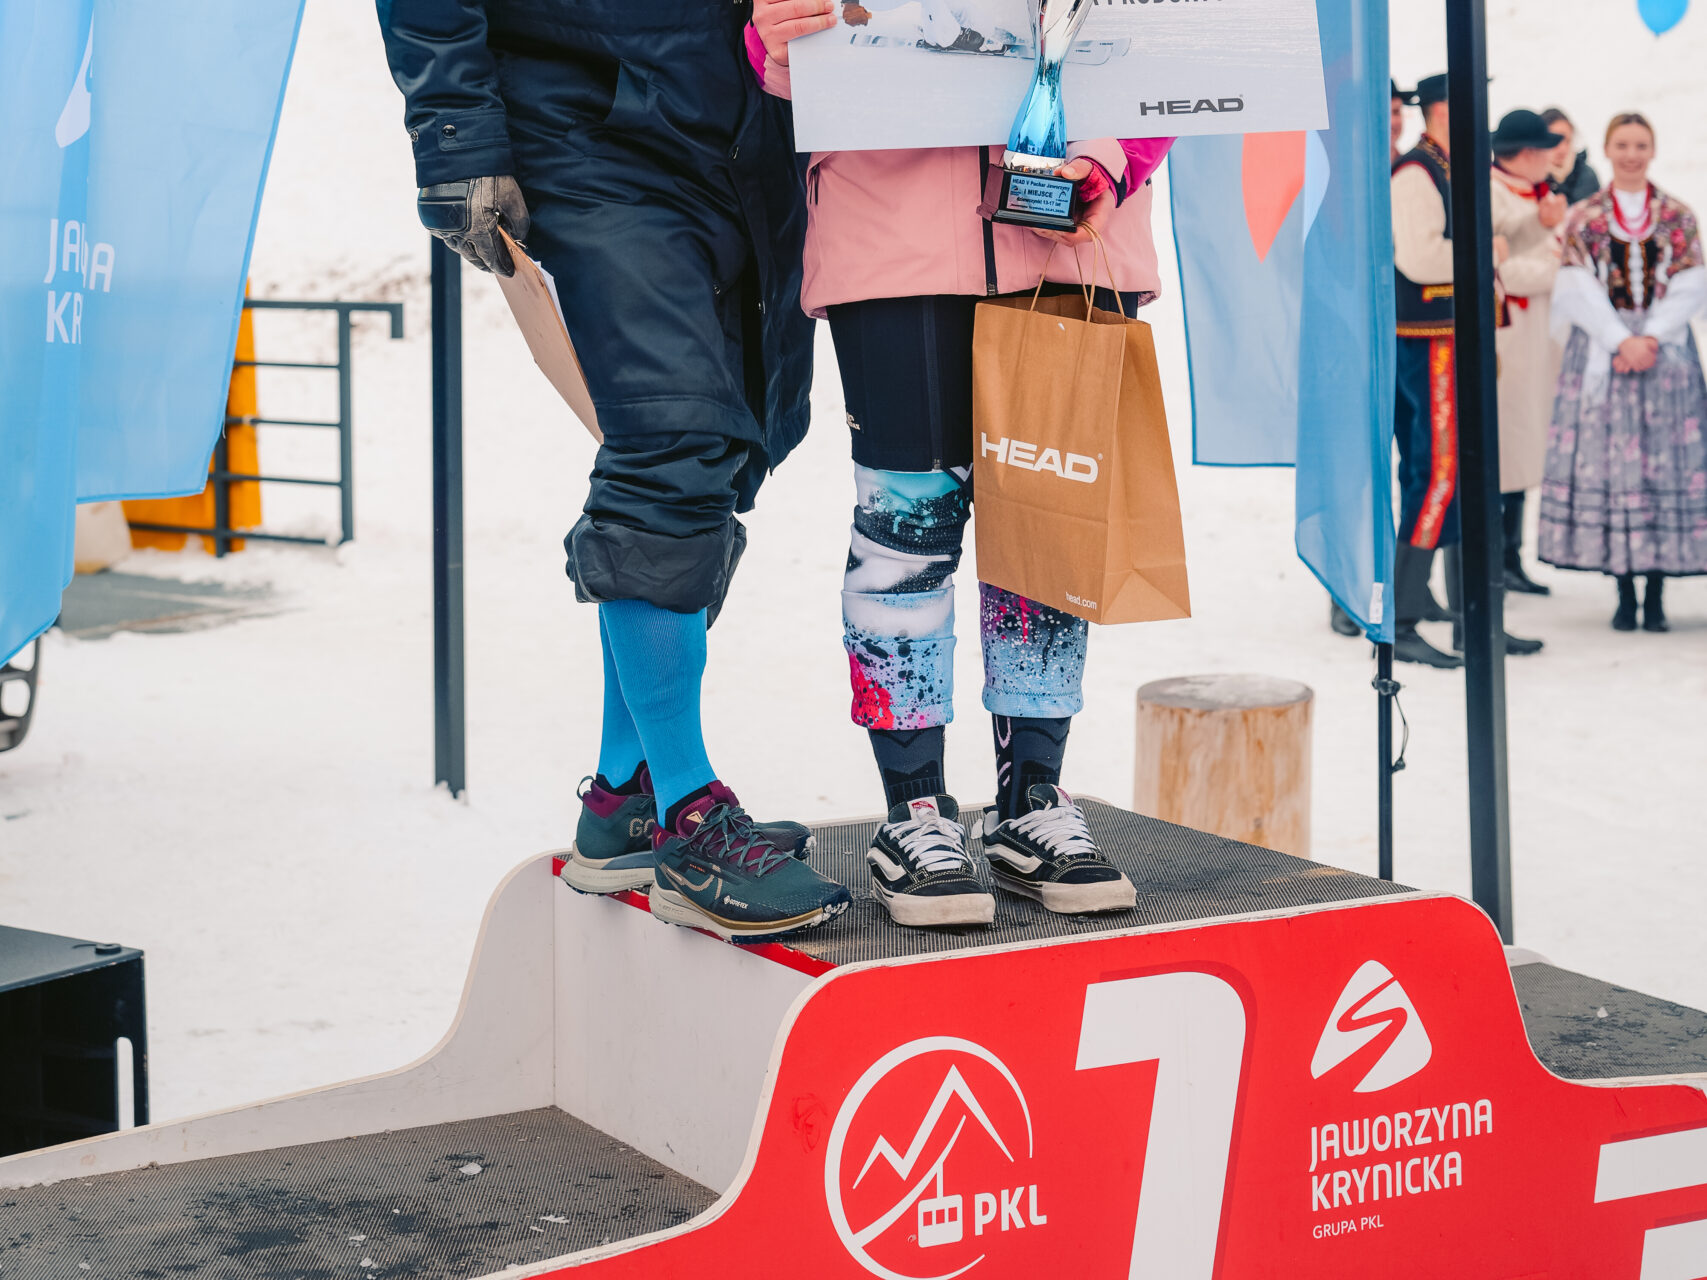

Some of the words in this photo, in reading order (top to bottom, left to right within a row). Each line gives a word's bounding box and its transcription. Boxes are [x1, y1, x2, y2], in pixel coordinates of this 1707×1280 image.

[1139, 97, 1244, 116] HEAD
[1027, 189, 1054, 198] MIEJSCE
[981, 432, 1098, 483] HEAD
[1066, 592, 1097, 610] head.com
[1308, 1099, 1493, 1172] JAWORZYNA
[1312, 1151, 1462, 1211] KRYNICKA
[974, 1184, 1047, 1236] PKL
[1312, 1219, 1357, 1239] GRUPA
[1361, 1215, 1384, 1230] PKL
